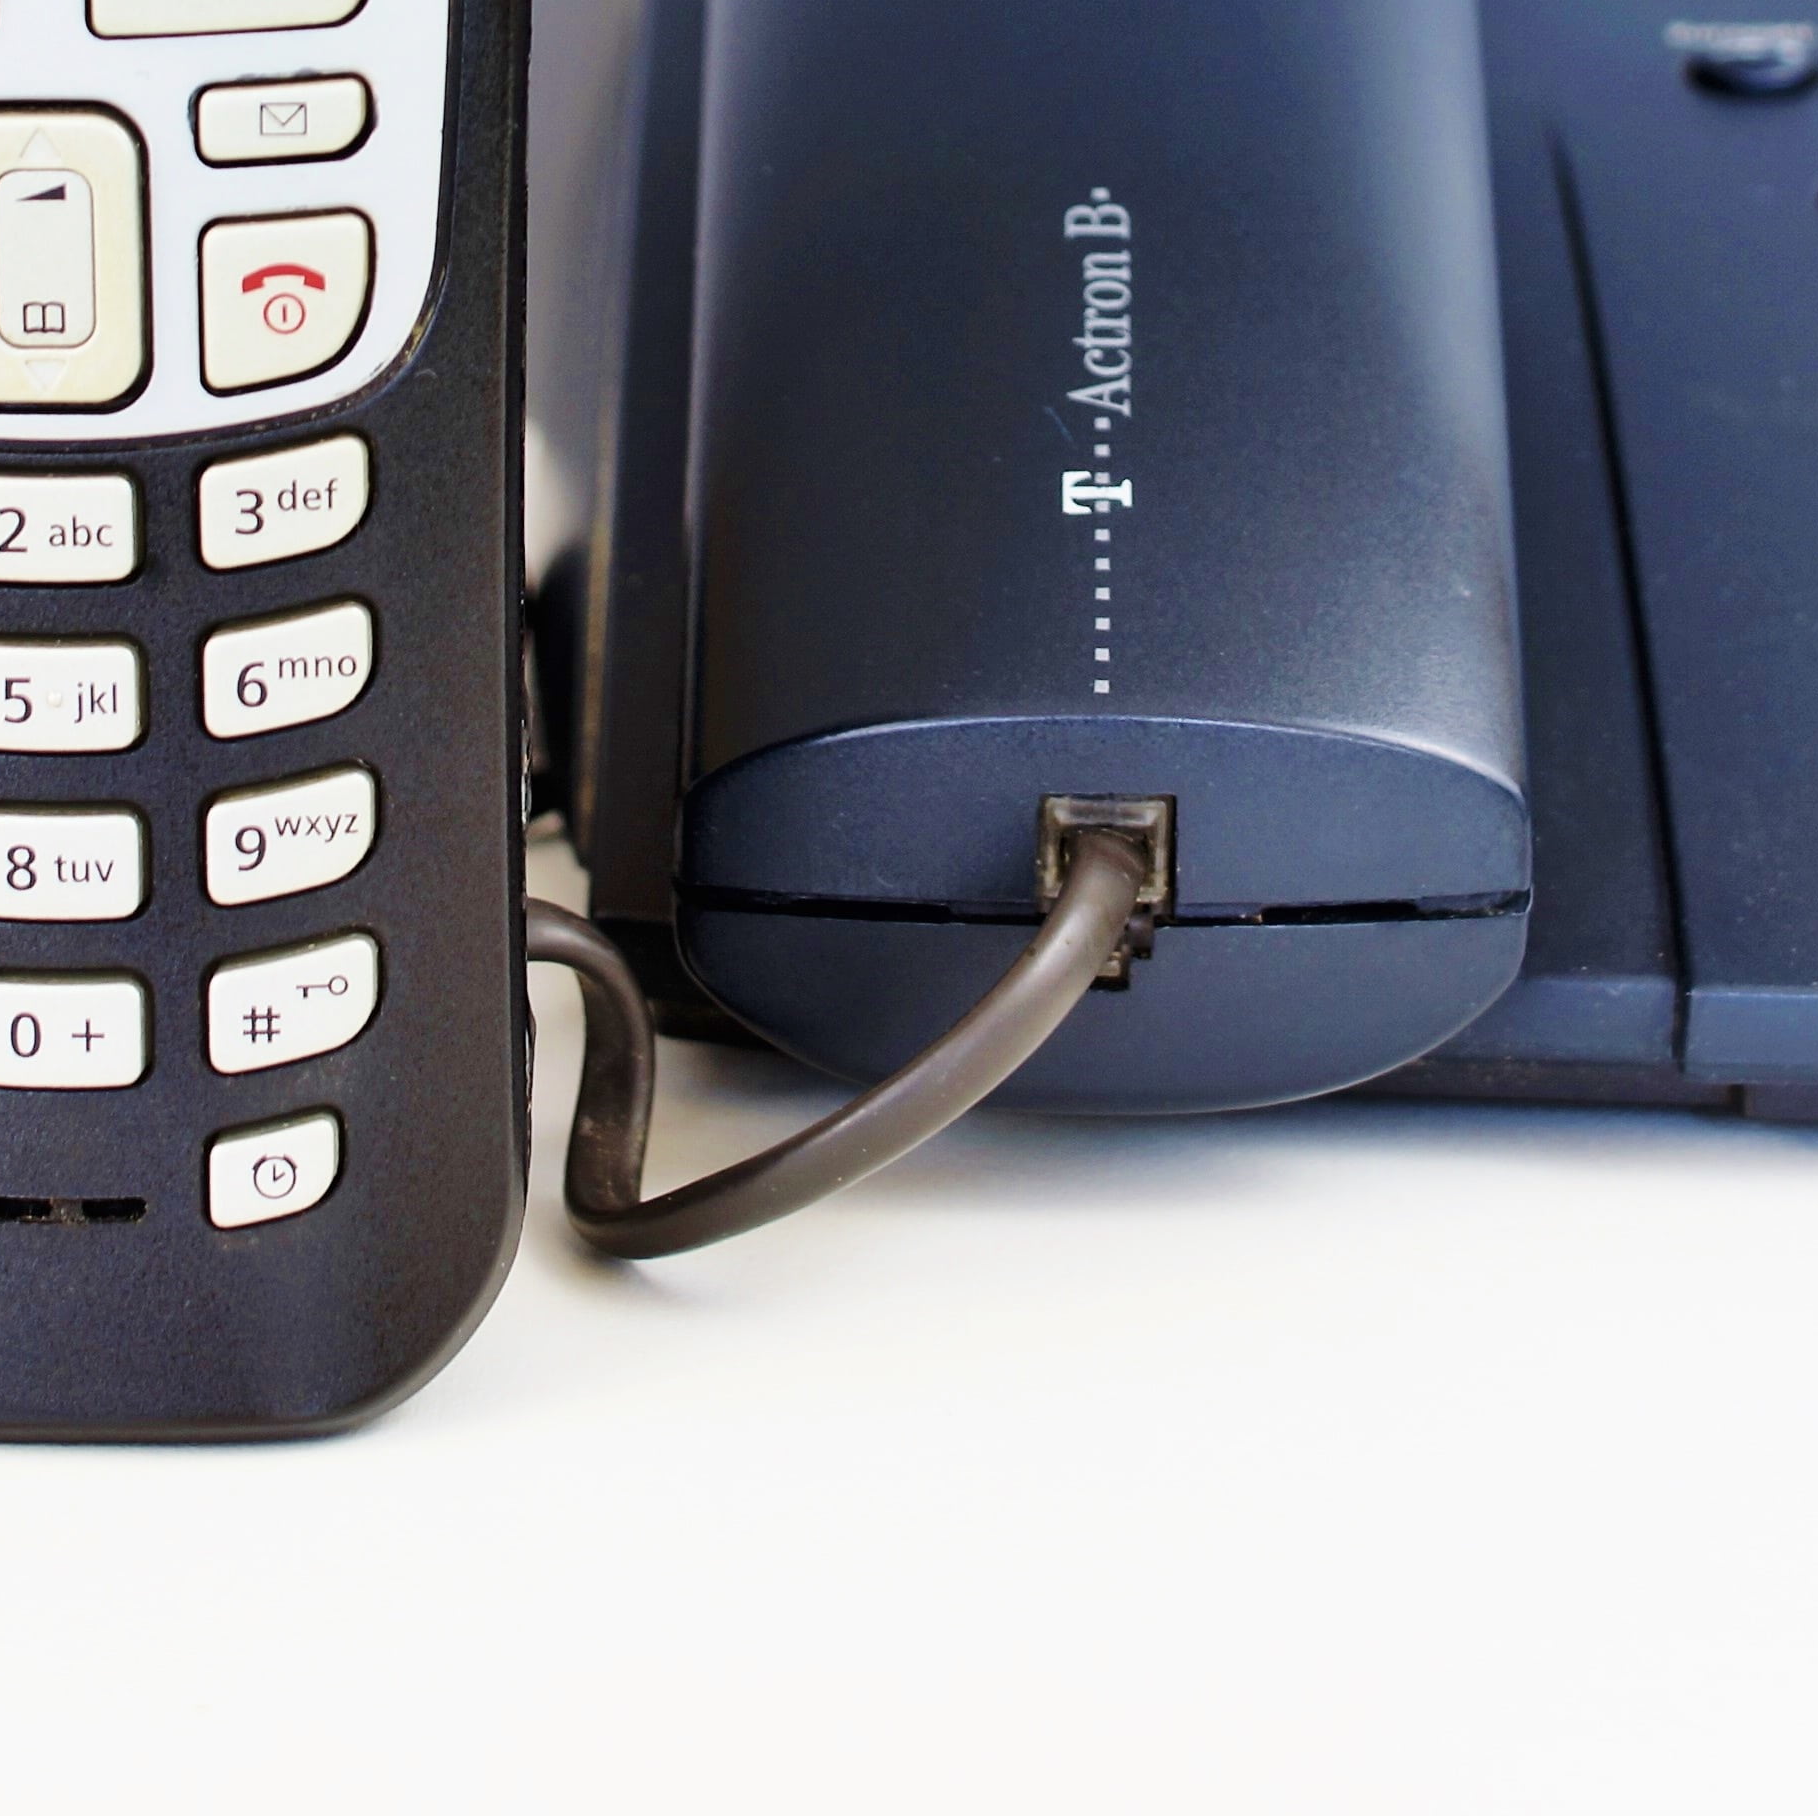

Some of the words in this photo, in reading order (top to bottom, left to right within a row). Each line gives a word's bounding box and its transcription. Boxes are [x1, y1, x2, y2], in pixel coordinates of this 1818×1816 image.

[1065, 250, 1132, 418] Actron
[235, 490, 264, 535] 3
[277, 479, 338, 512] def
[1062, 470, 1133, 515] T
[48, 516, 113, 548] abc
[3, 677, 33, 724] 5
[74, 682, 119, 724] jkl
[236, 662, 268, 708] 6
[277, 655, 358, 680] mno
[234, 826, 266, 871] 9
[275, 814, 359, 842] wxyz
[6, 846, 38, 891] 8
[54, 855, 114, 884] tuv
[10, 1013, 41, 1058] 0
[243, 1006, 281, 1044] #
